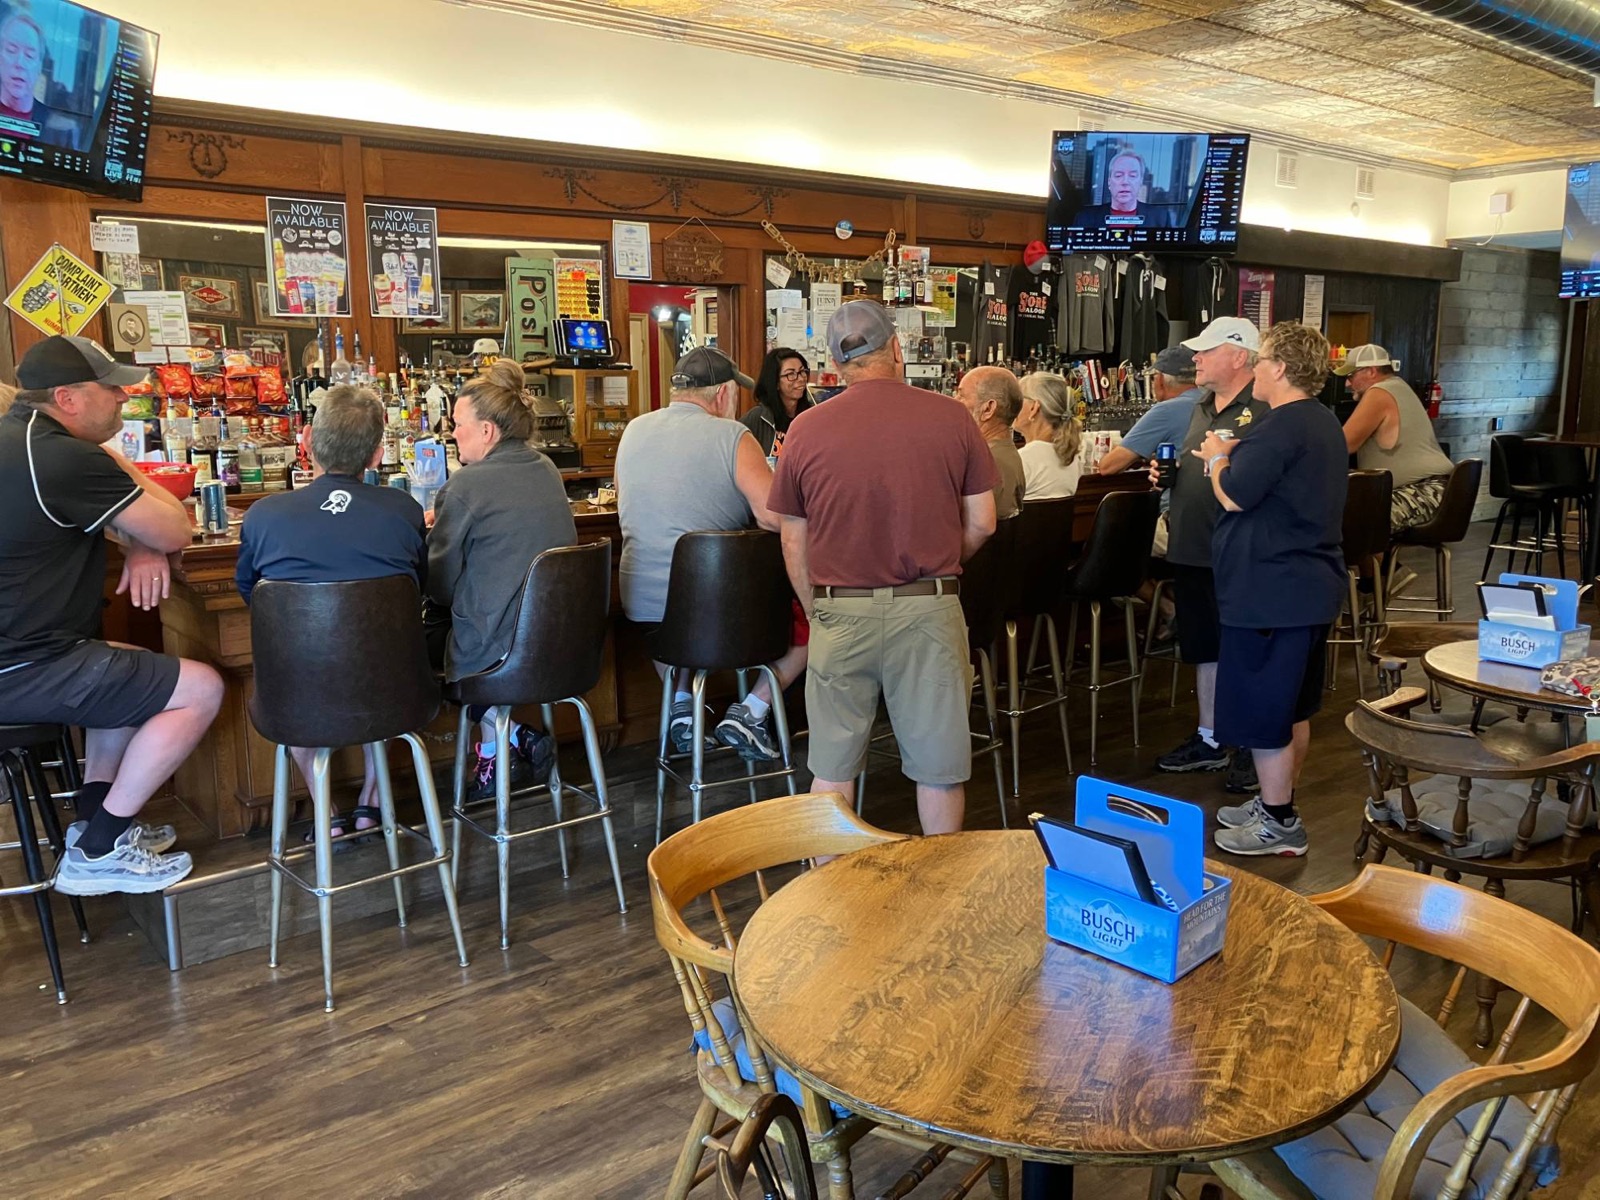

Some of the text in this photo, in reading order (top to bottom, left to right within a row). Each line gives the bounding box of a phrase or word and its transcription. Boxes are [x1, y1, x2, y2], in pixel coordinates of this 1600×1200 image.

[290, 204, 323, 217] NOW
[384, 209, 414, 222] NOW
[274, 214, 340, 229] AVAILABLE
[370, 220, 430, 234] AVAILABLE
[55, 255, 102, 293] COMPLAINT
[517, 275, 549, 348] POST
[1501, 636, 1536, 653] BUSCH
[1507, 647, 1528, 656] LIGHT
[1183, 891, 1227, 925] HEAD FOR THE
[1186, 903, 1222, 930] MOUNTAINS
[1081, 908, 1136, 943] BUSCH
[1092, 929, 1125, 947] LIGHT
